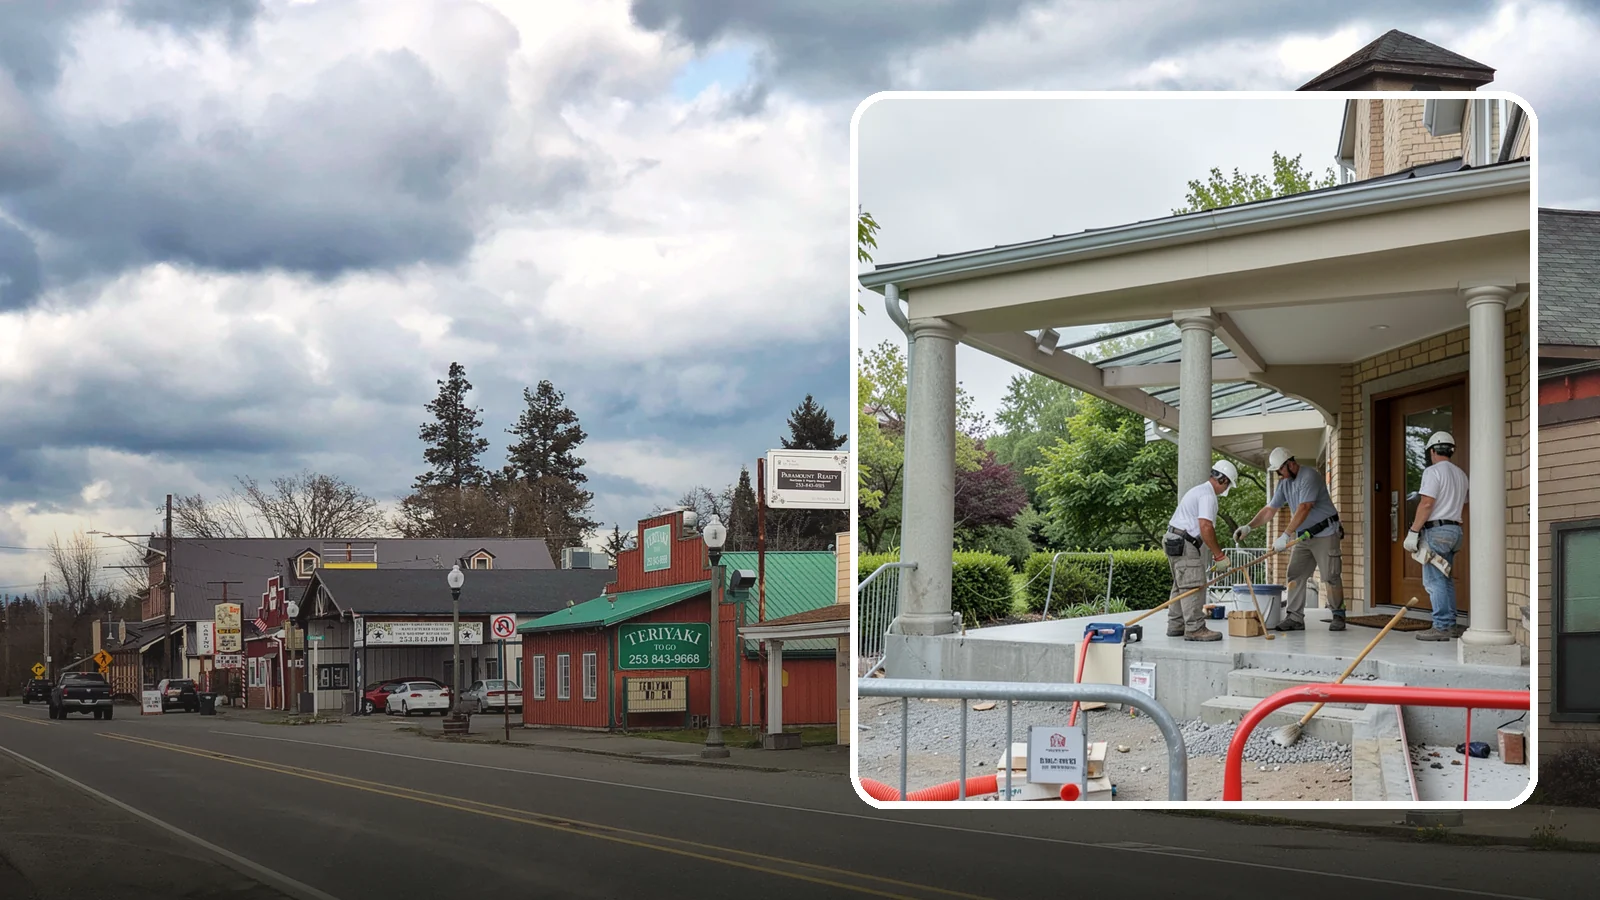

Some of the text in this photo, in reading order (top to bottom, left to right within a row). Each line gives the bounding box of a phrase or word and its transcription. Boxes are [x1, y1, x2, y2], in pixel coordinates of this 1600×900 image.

[817, 472, 839, 480] REALTY
[625, 627, 702, 646] TERIYAKI
[629, 653, 700, 665] 253 843-9668
